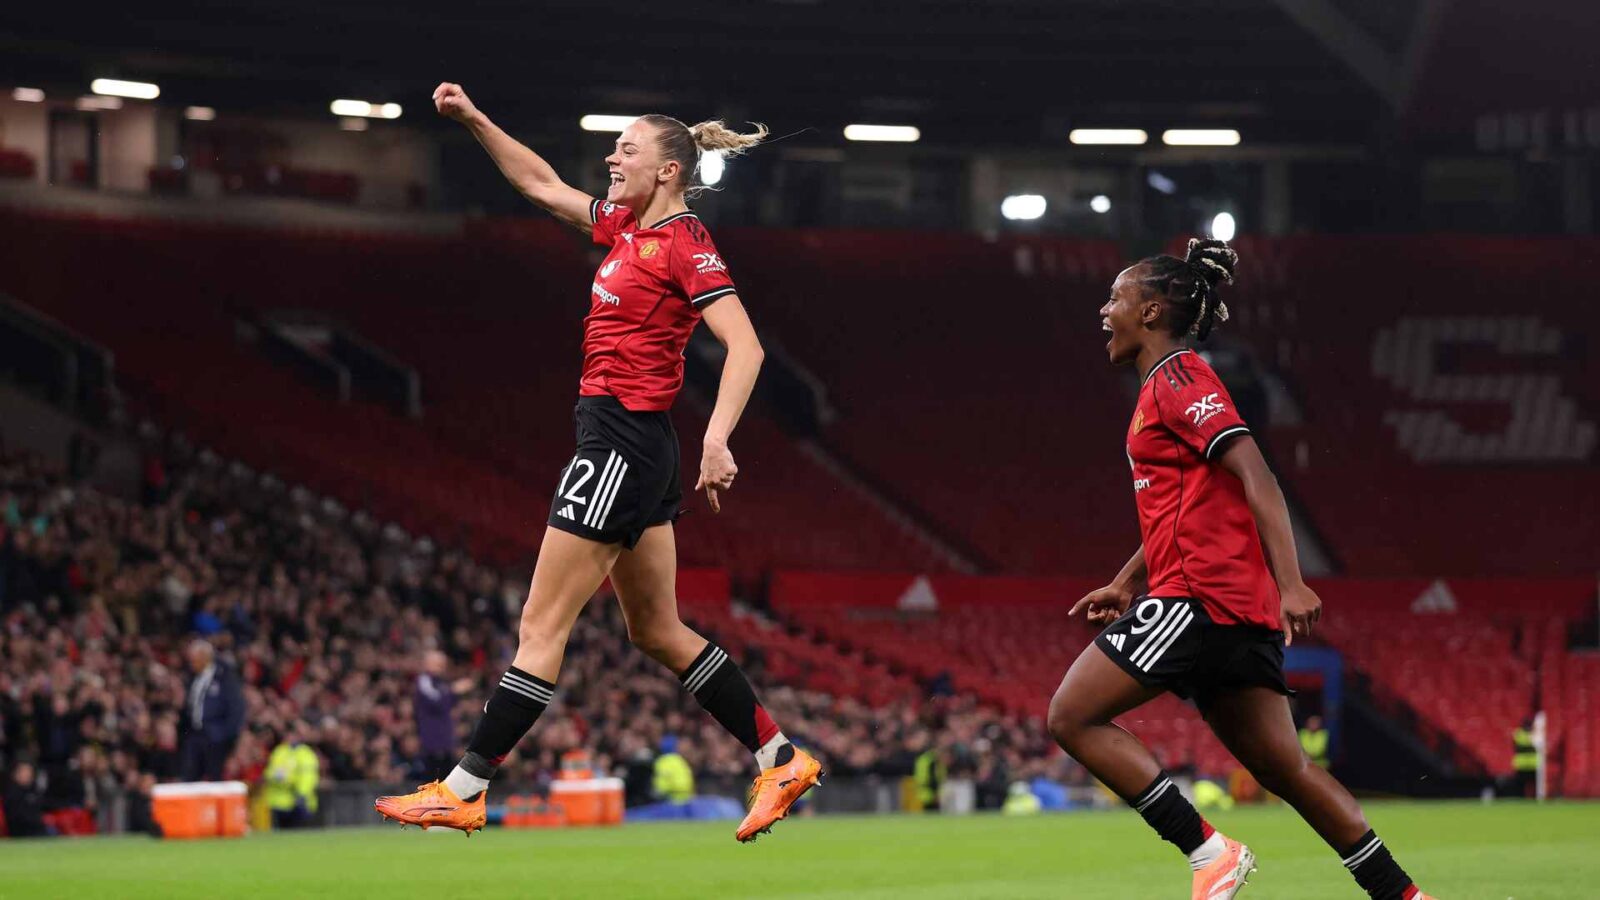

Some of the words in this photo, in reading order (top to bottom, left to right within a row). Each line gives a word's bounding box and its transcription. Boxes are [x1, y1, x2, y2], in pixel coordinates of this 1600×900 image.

[1185, 393, 1224, 424] DXC
[558, 455, 595, 505] 12
[1131, 598, 1164, 634] 9
